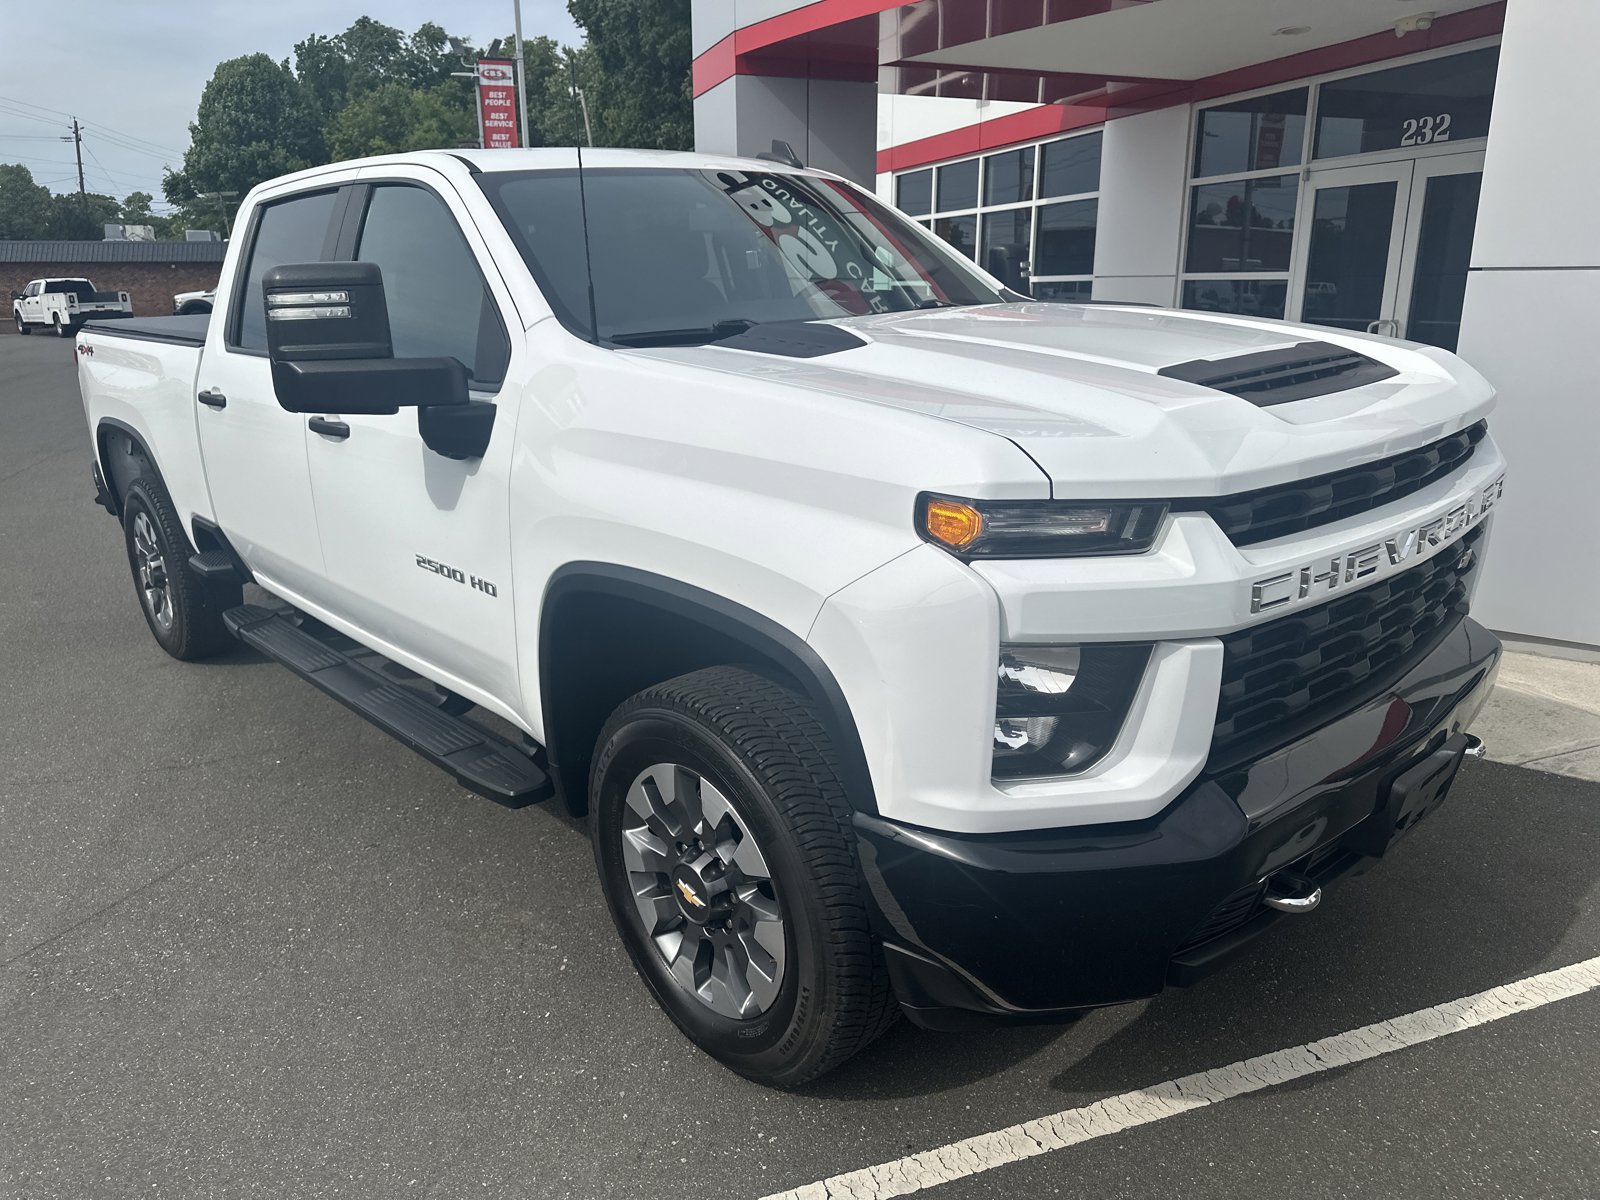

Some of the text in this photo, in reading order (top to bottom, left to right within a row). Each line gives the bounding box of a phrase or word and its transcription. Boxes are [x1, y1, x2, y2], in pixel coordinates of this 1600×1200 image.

[1400, 113, 1451, 147] 232
[1250, 472, 1505, 614] CHEVROLET
[415, 552, 498, 598] 2500 HD
